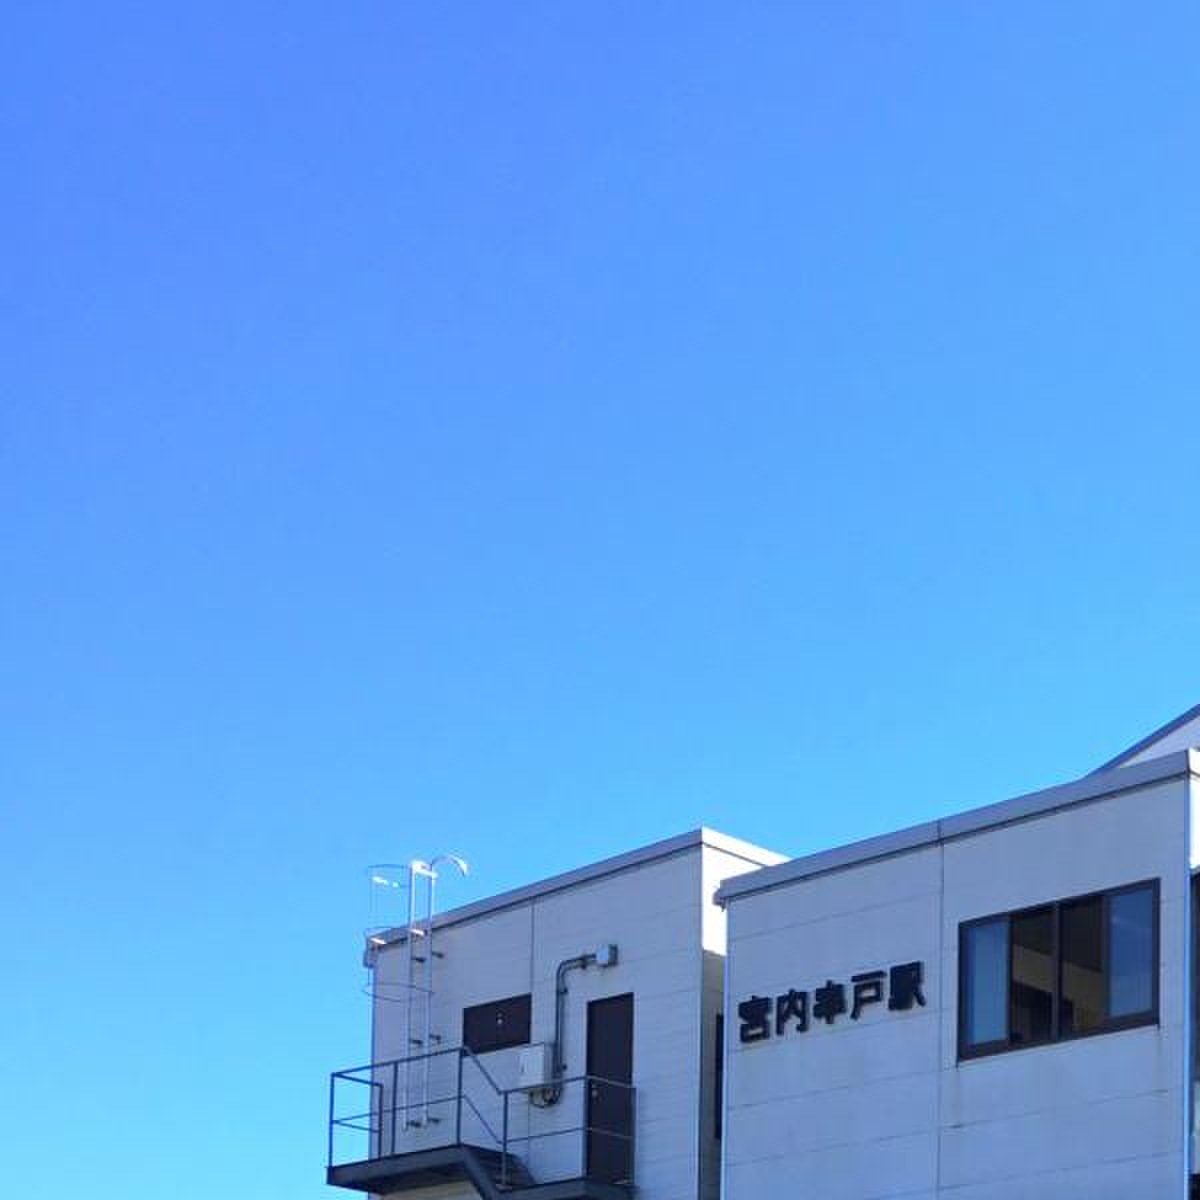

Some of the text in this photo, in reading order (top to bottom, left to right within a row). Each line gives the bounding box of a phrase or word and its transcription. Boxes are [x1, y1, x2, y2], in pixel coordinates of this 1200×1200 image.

[738, 961, 927, 1043] 宮内串戸駅
